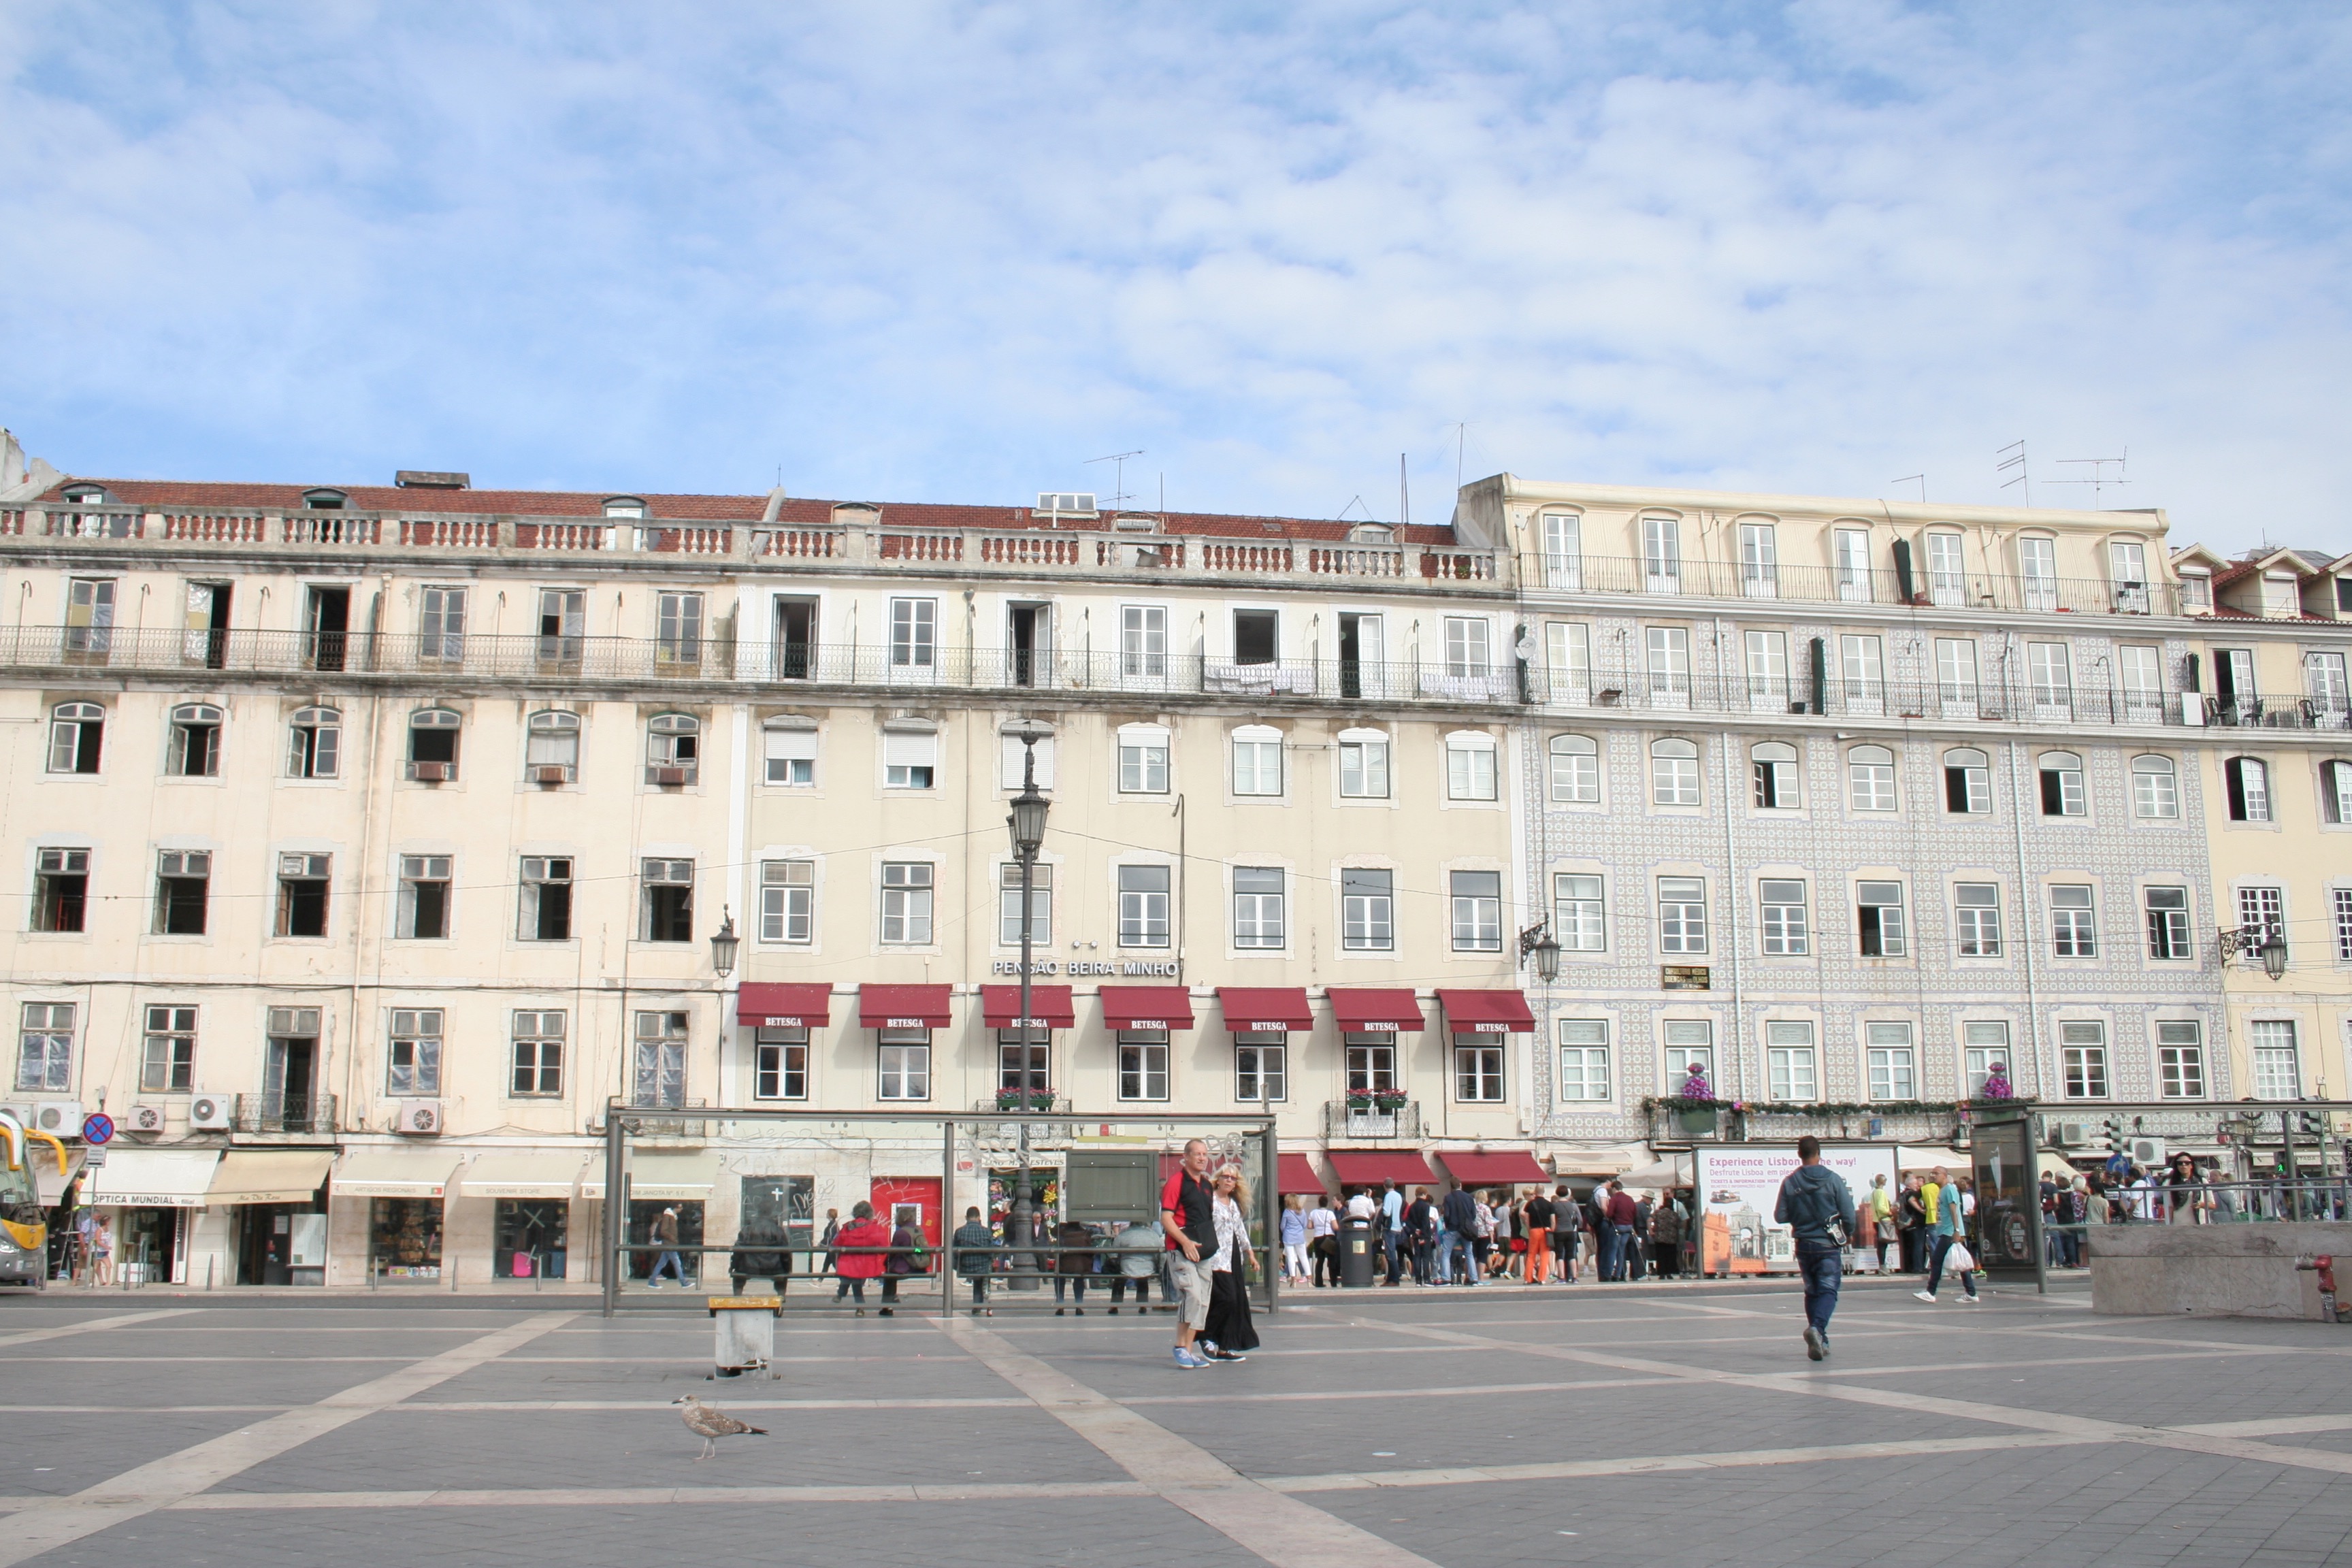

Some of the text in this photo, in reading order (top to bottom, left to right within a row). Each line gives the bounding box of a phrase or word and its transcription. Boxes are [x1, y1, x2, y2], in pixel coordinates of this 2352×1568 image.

[1068, 961, 1115, 975] BEIRA
[1124, 962, 1178, 976] MINHO
[765, 1017, 802, 1027] BETESGA
[887, 1019, 924, 1028] BETESGA
[1011, 1019, 1048, 1028] BESGA
[1131, 1020, 1167, 1029] BETESGA
[1252, 1022, 1287, 1030] BETESGA
[1364, 1022, 1399, 1031] BETESGA
[1475, 1024, 1510, 1032] BETESGA
[1709, 1157, 1857, 1168] Experience Lisbon he way!
[131, 1196, 175, 1205] MUNDIAL
